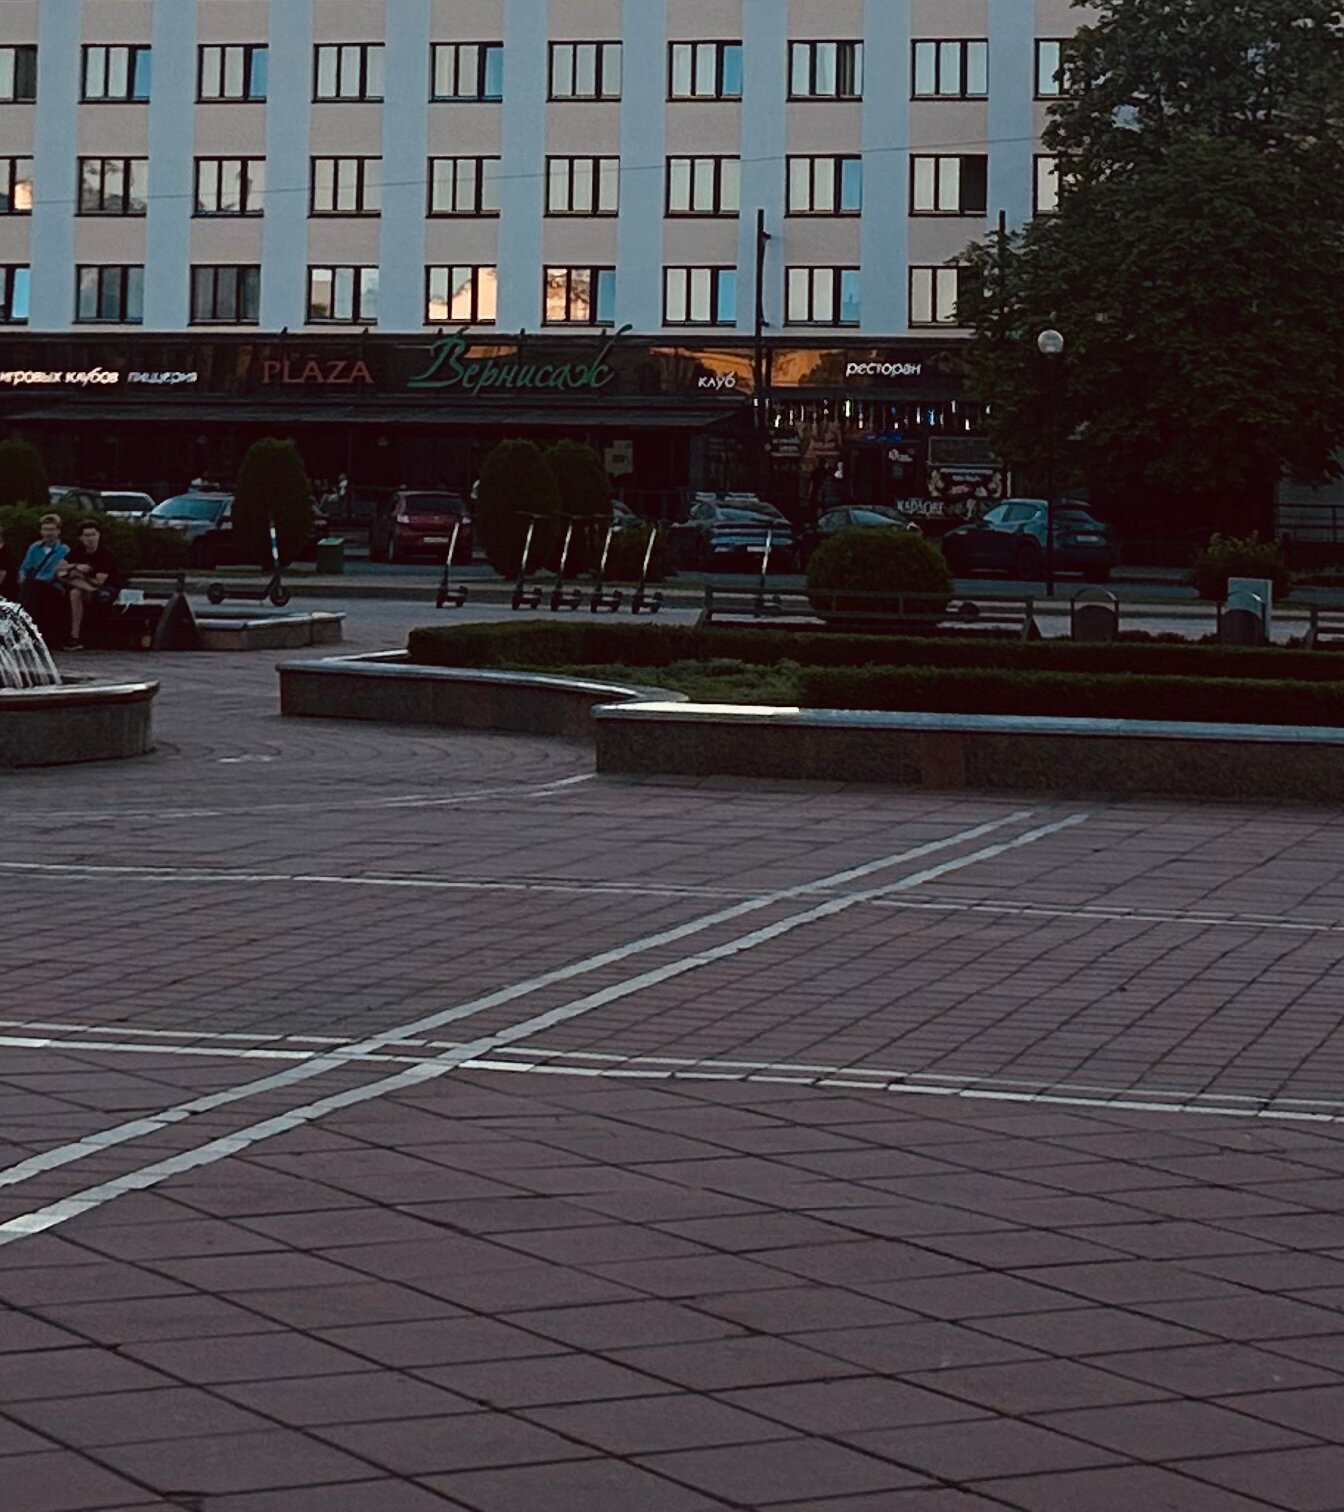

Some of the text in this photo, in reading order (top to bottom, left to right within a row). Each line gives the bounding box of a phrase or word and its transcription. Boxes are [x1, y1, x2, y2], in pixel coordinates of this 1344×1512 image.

[406, 325, 633, 395] Вернисаж
[846, 362, 922, 377] ресторан
[0, 371, 62, 386] игровых
[65, 367, 119, 386] клубов
[127, 371, 198, 385] пиццерия
[262, 360, 375, 384] PLAZA
[698, 371, 735, 390] клуб
